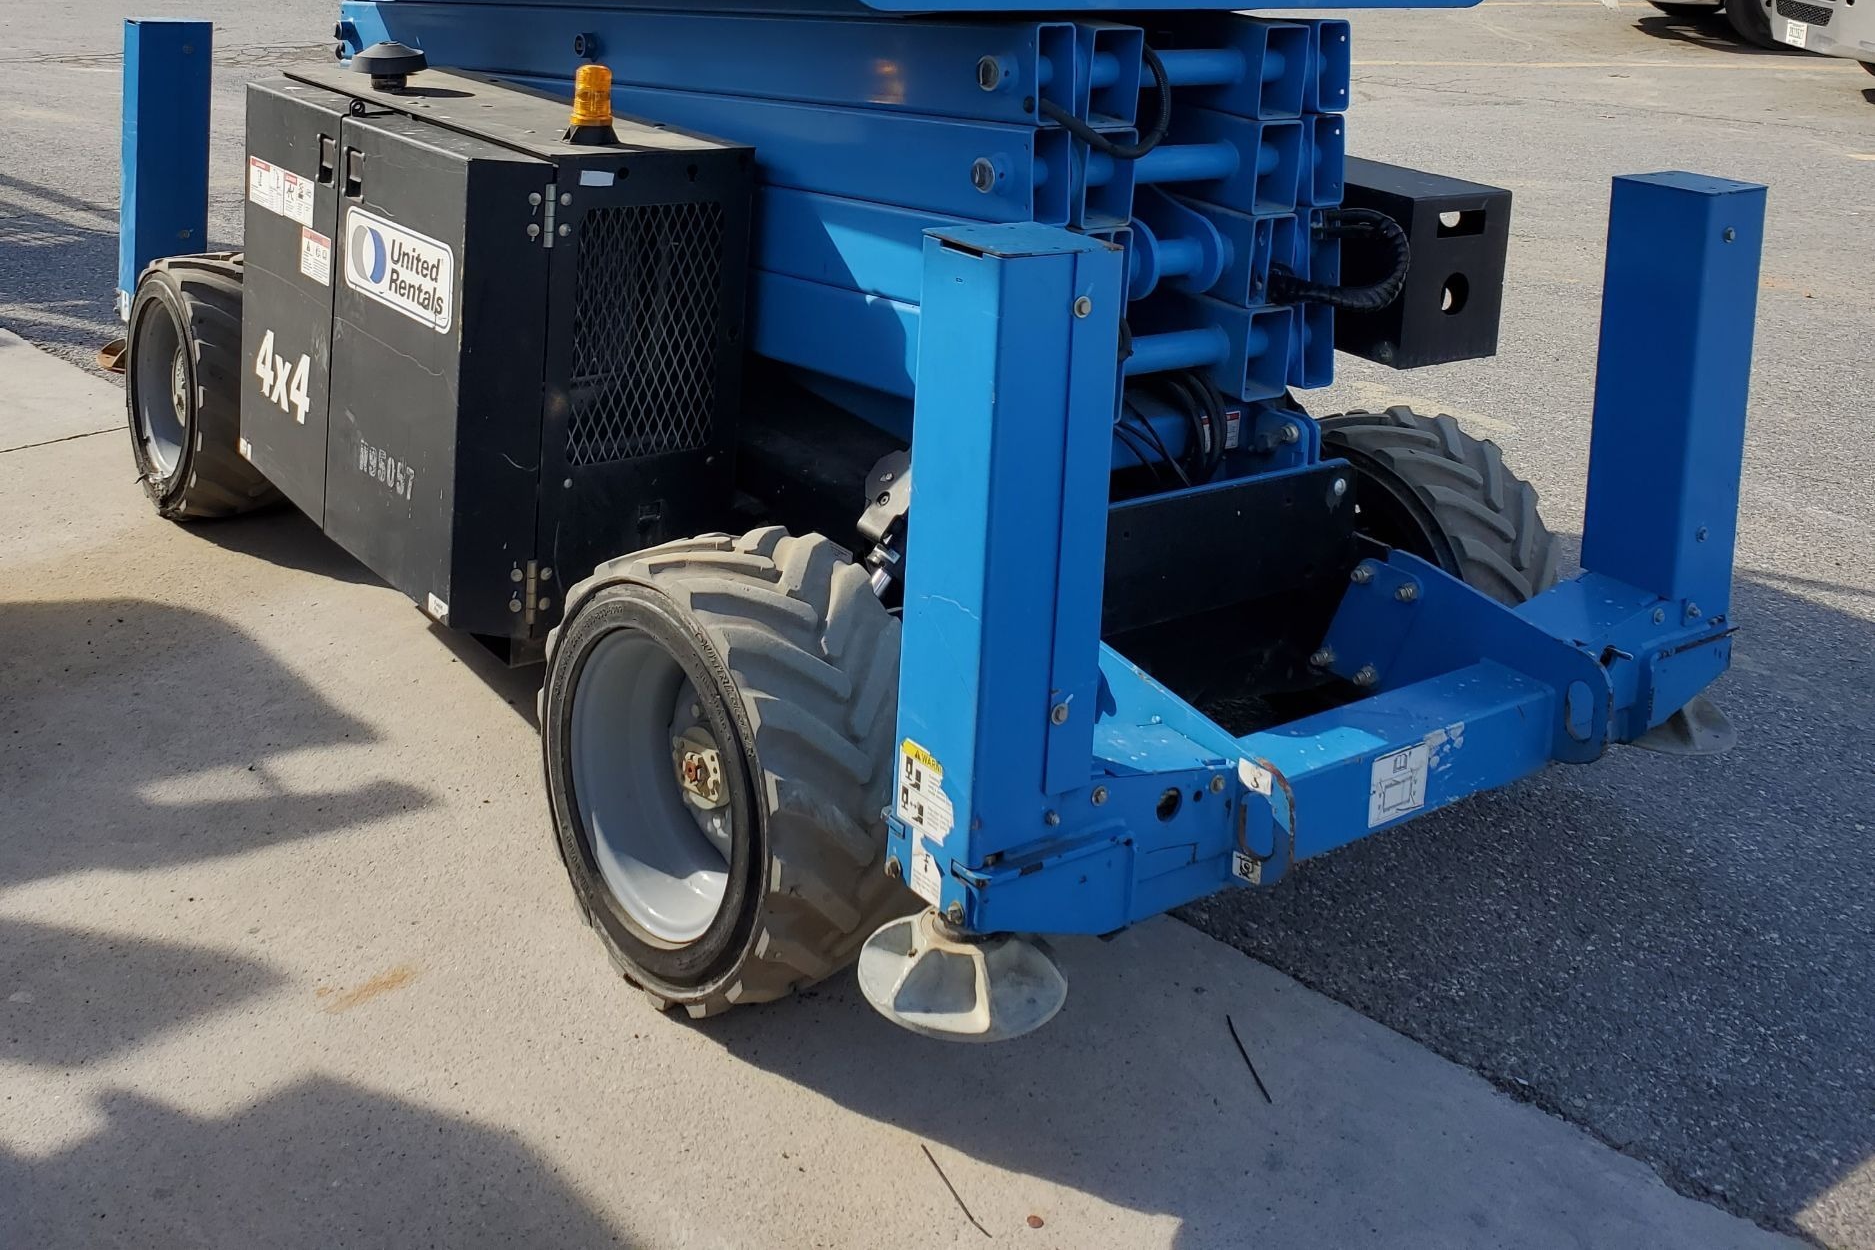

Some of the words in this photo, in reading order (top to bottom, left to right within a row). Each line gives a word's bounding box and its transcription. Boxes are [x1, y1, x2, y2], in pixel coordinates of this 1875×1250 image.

[390, 238, 442, 284] United
[388, 267, 444, 316] Rentals
[255, 329, 311, 425] 4x4
